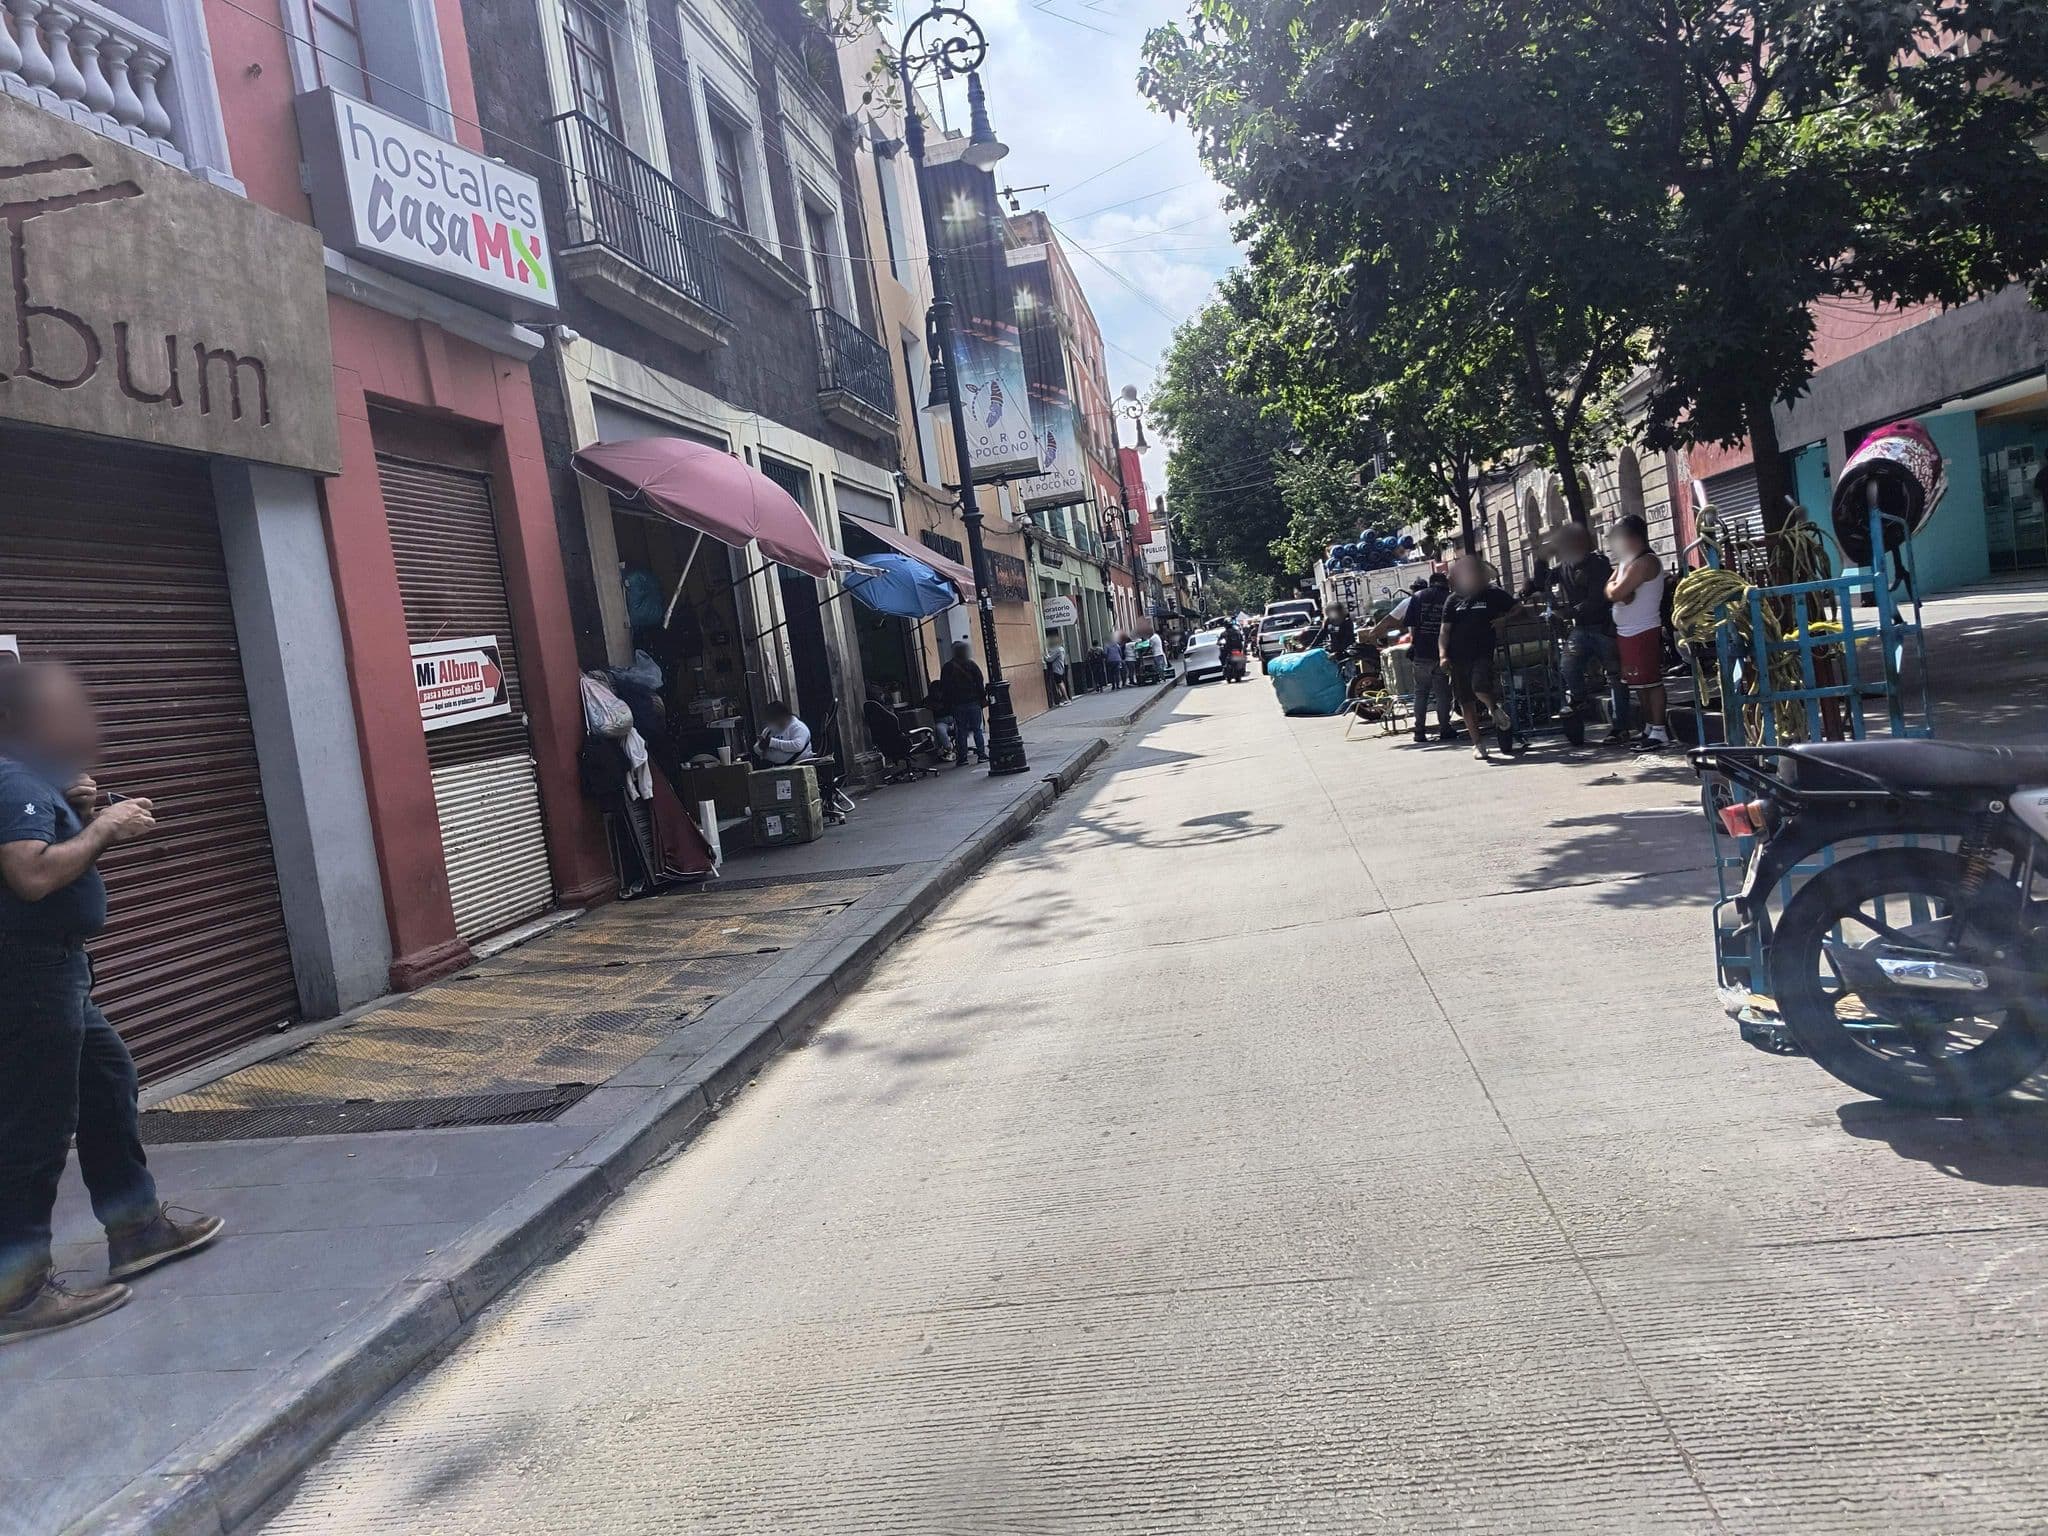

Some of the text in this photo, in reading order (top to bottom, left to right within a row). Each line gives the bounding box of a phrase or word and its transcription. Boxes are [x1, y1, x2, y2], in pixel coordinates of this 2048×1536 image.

[346, 104, 537, 229] hostales
[0, 212, 272, 428] bum
[979, 430, 1027, 446] ORO
[976, 444, 1009, 458] POCO
[1011, 441, 1029, 452] NO
[1035, 480, 1061, 491] POCO
[1063, 478, 1077, 487] NO
[416, 659, 479, 687] Mi Album
[442, 687, 454, 698] local
